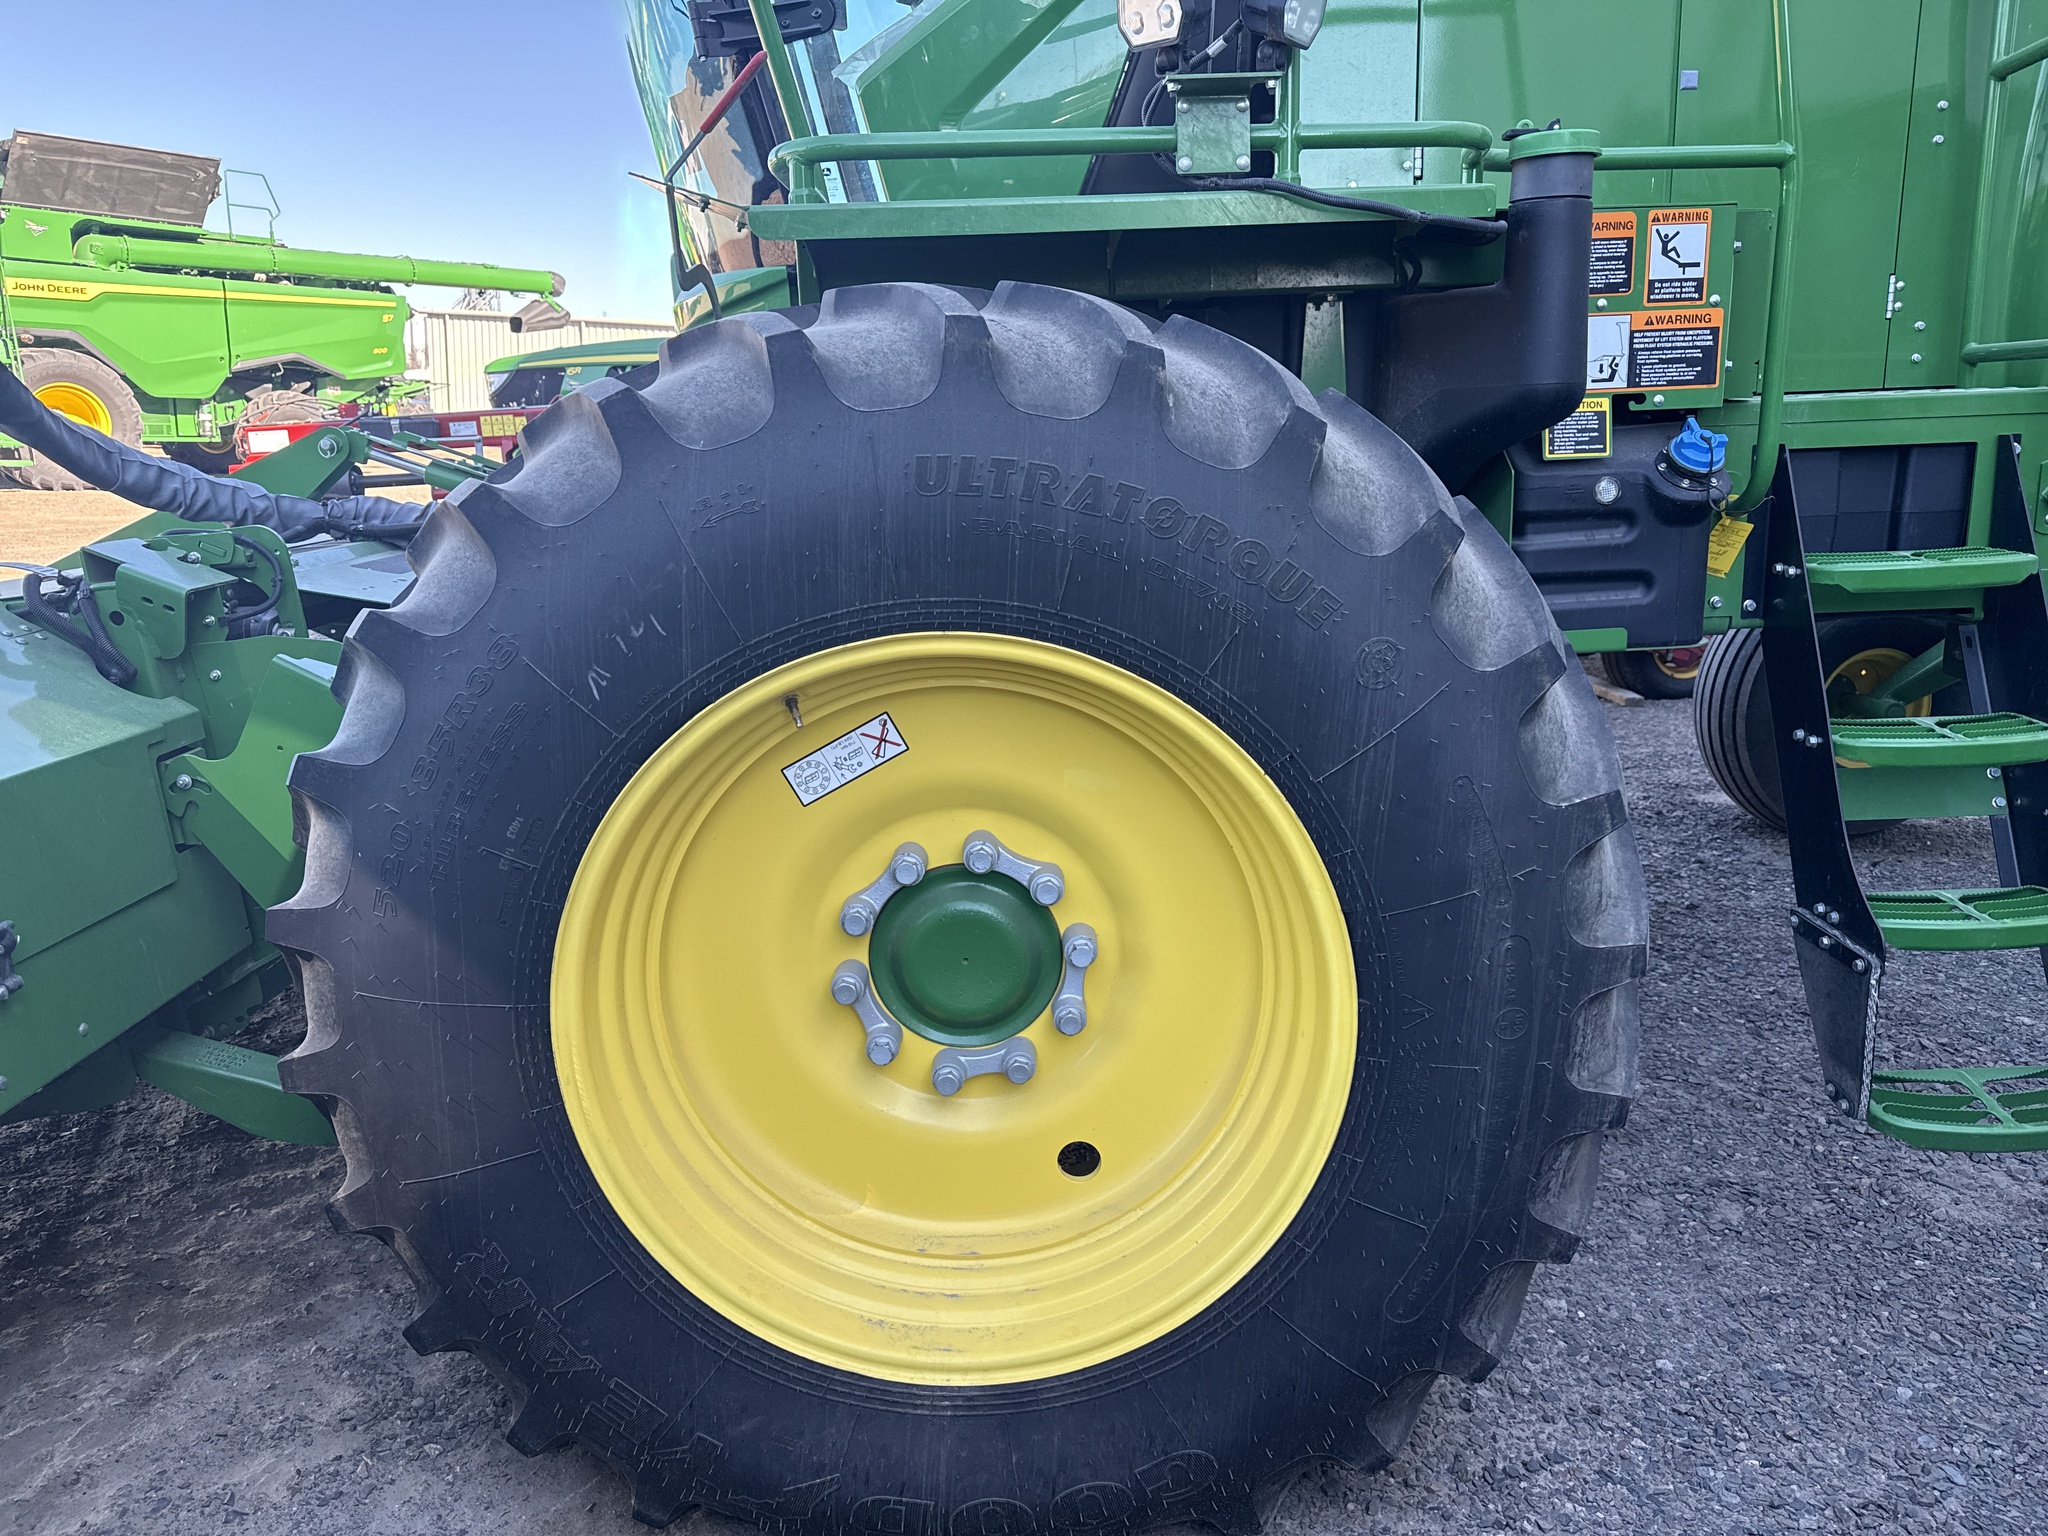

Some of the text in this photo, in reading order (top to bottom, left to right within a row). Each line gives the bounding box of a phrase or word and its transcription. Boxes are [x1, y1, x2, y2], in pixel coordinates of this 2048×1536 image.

[1662, 211, 1709, 222] WARNING
[1592, 220, 1634, 231] ARNING
[12, 281, 88, 295] JOHN DEERE
[1655, 313, 1712, 325] WARNING
[1581, 401, 1602, 409] TION
[914, 453, 1345, 631] ULTRATORQUE
[971, 517, 1123, 562] RADIAL
[428, 700, 529, 885] TUBELESS
